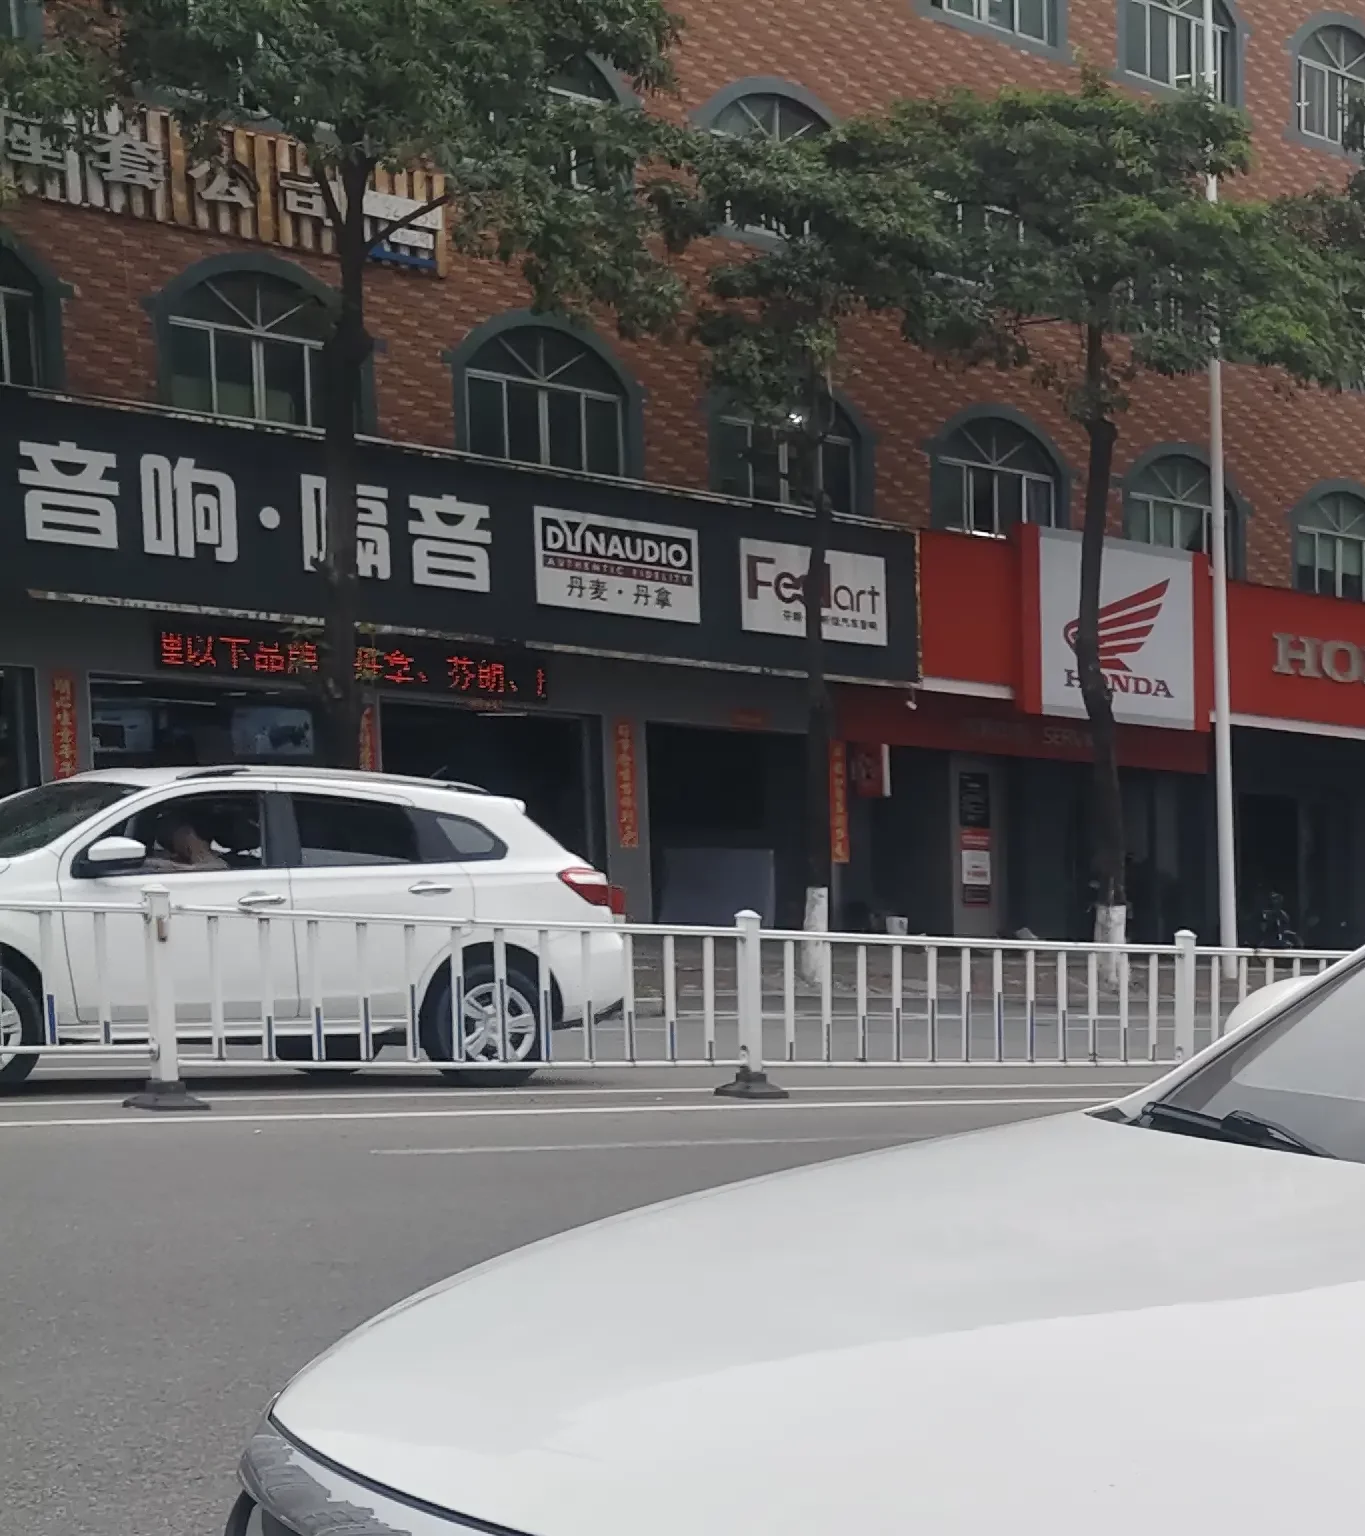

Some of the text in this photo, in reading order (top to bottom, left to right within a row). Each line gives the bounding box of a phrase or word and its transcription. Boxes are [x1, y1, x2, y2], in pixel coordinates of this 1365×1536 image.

[546, 519, 688, 568] DYNAUDIO
[547, 557, 625, 576] AUTHENTIC
[567, 575, 672, 609] 丹麦·丹拿
[1064, 668, 1175, 699] HNDA
